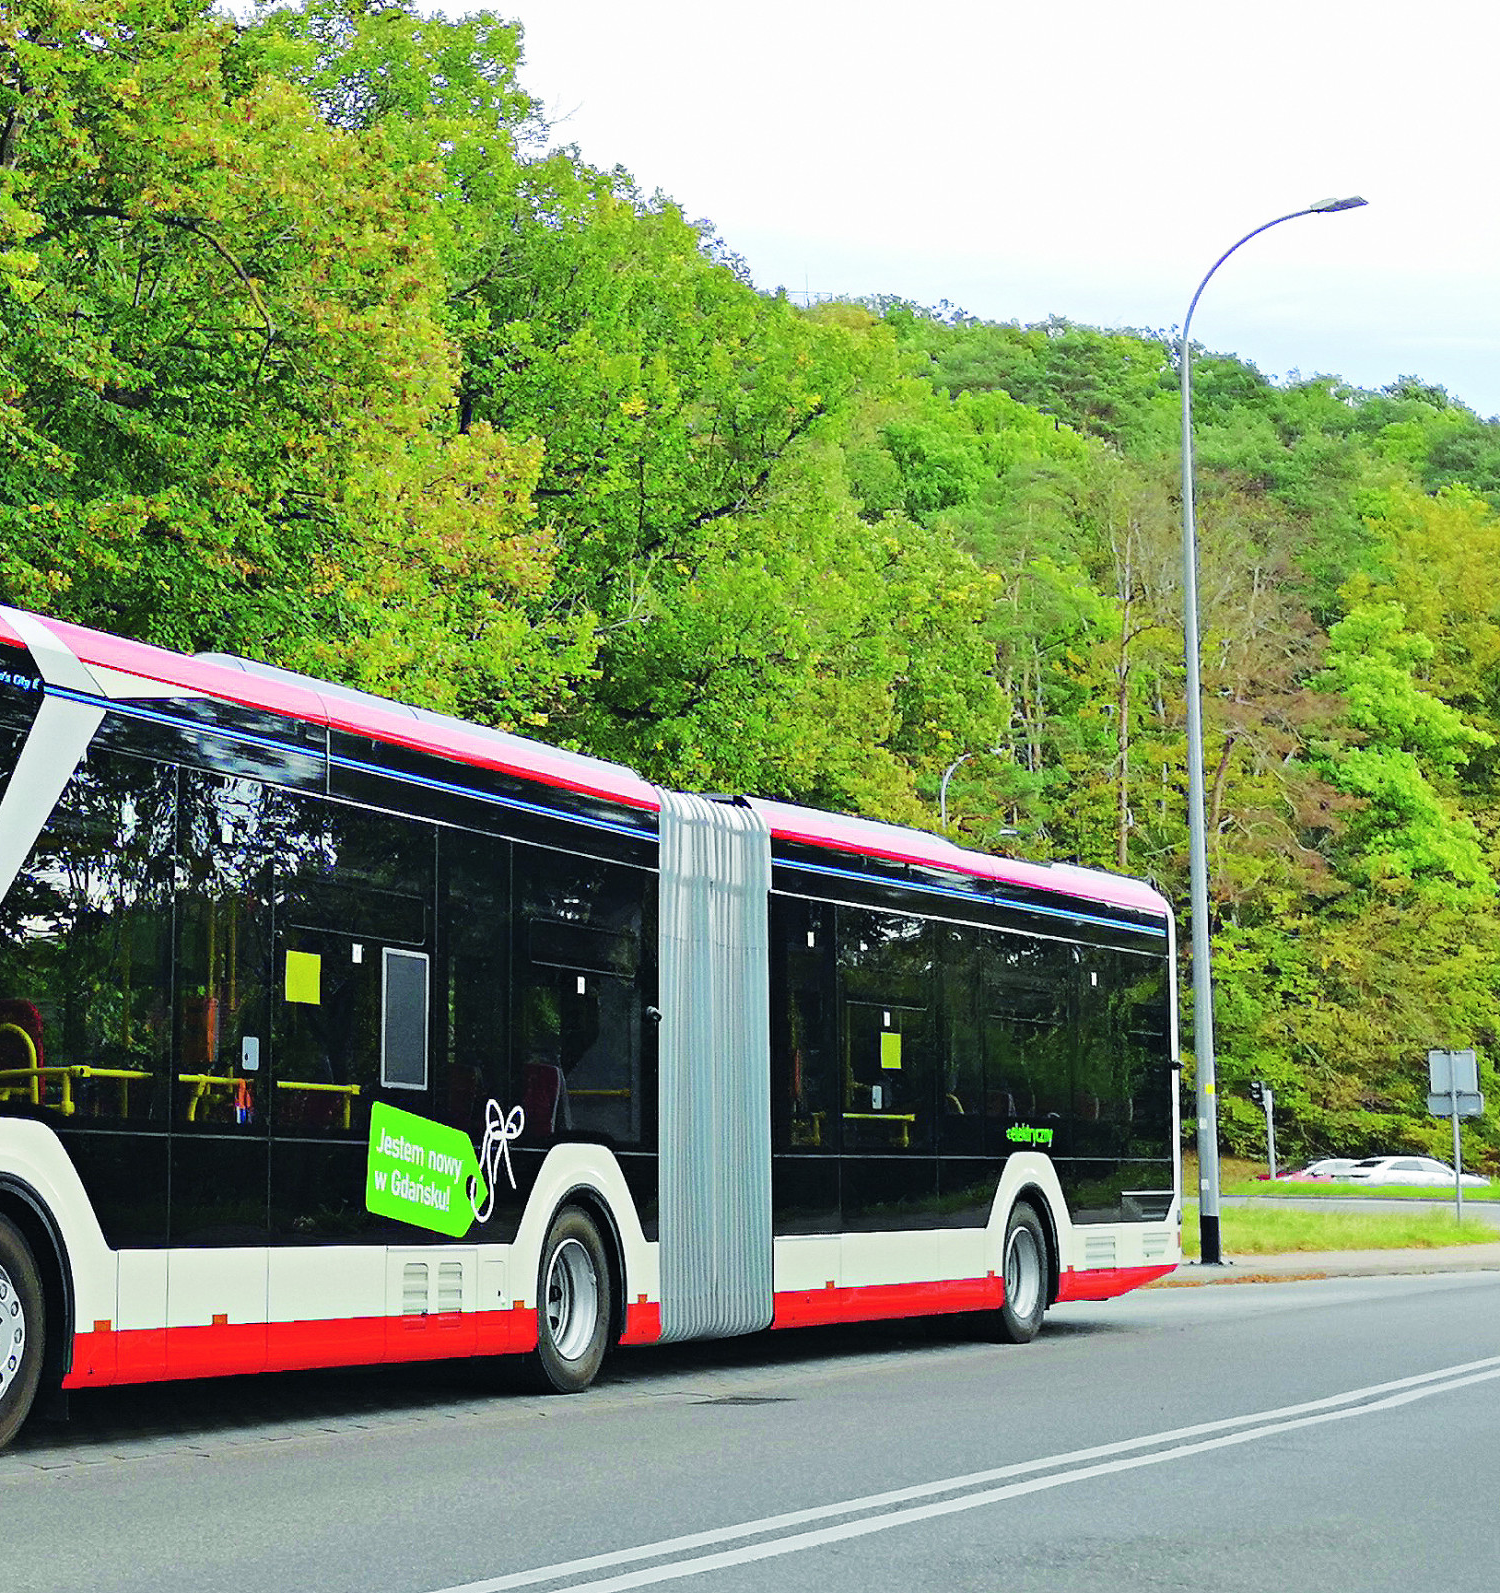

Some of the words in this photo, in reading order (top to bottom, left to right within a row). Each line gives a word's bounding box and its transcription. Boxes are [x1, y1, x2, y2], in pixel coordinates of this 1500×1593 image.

[376, 1127, 424, 1167] Jestem
[428, 1150, 464, 1185] nowy
[374, 1171, 388, 1191] w
[391, 1169, 451, 1212] Gdańsku!
